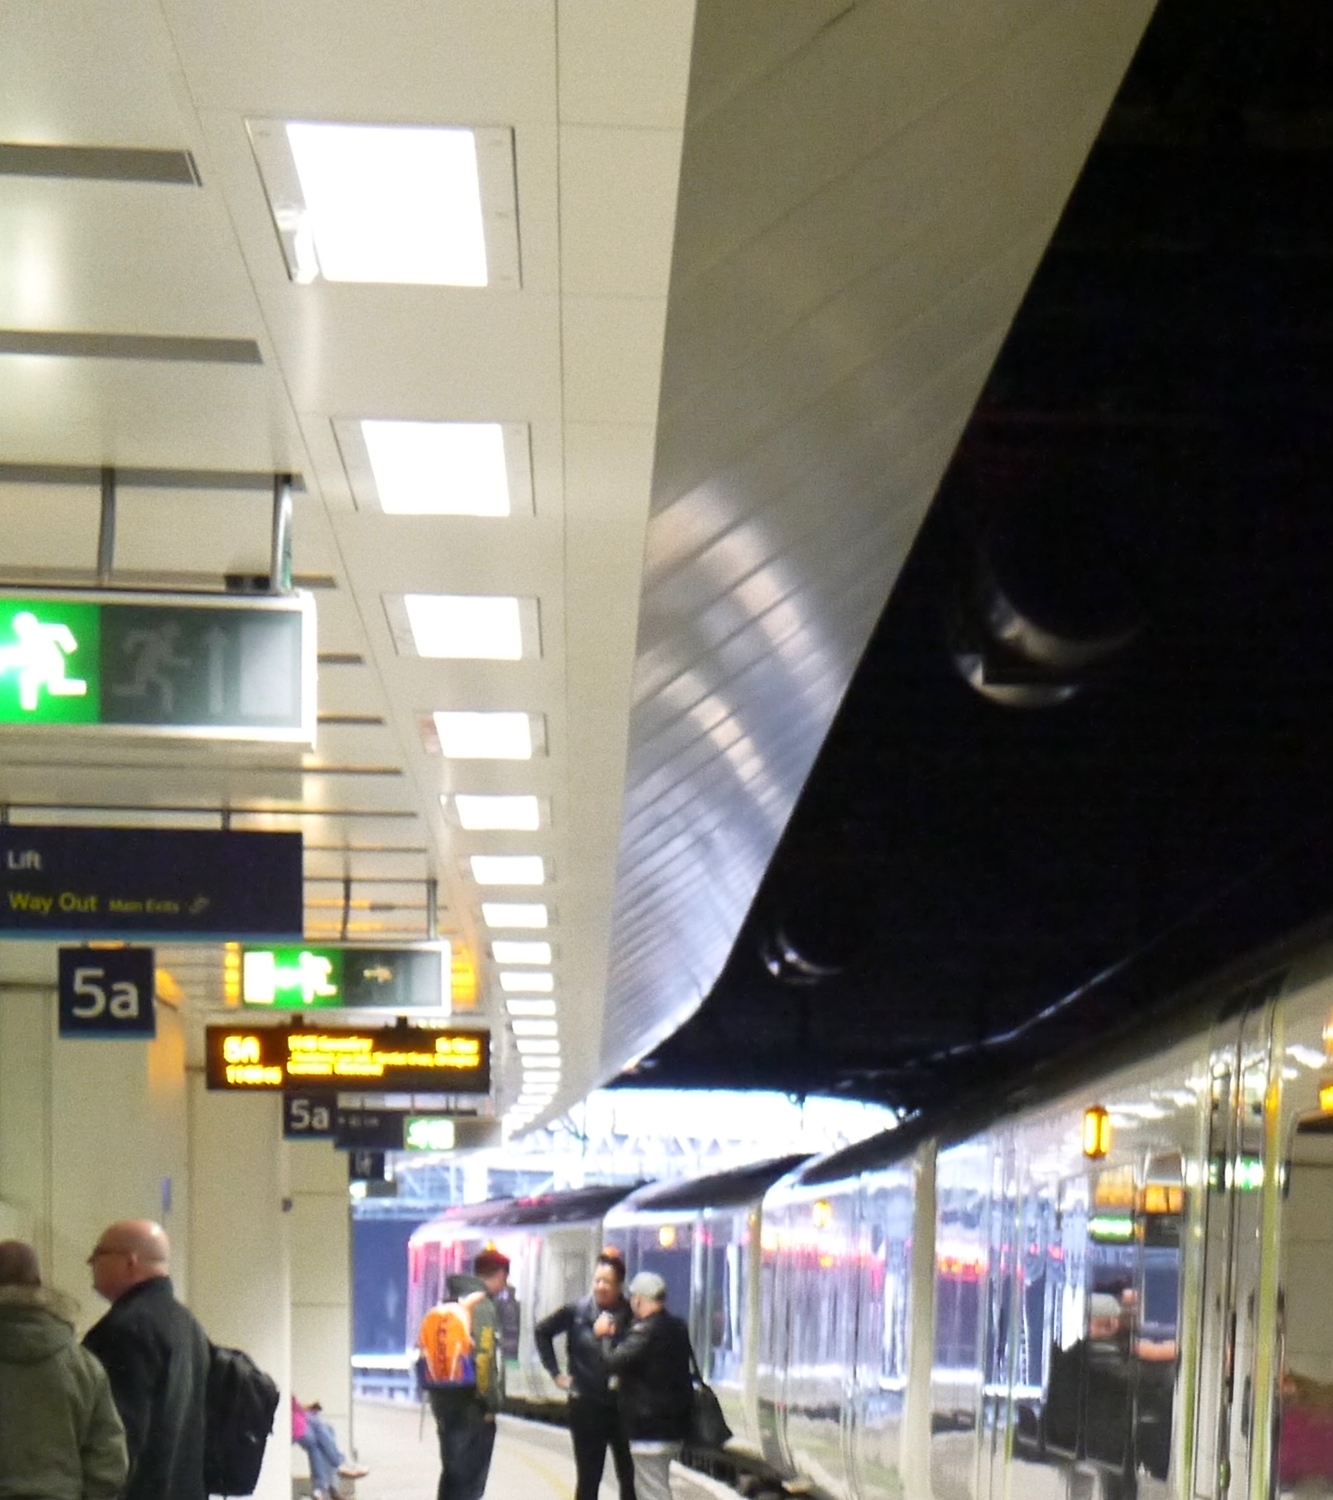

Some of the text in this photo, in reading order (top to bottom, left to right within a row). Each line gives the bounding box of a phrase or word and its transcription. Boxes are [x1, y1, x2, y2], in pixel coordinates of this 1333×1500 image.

[7, 850, 43, 871] Lift
[9, 892, 53, 916] Way
[58, 891, 99, 911] Out
[71, 967, 140, 1019] 5a
[290, 1098, 330, 1131] 5a
